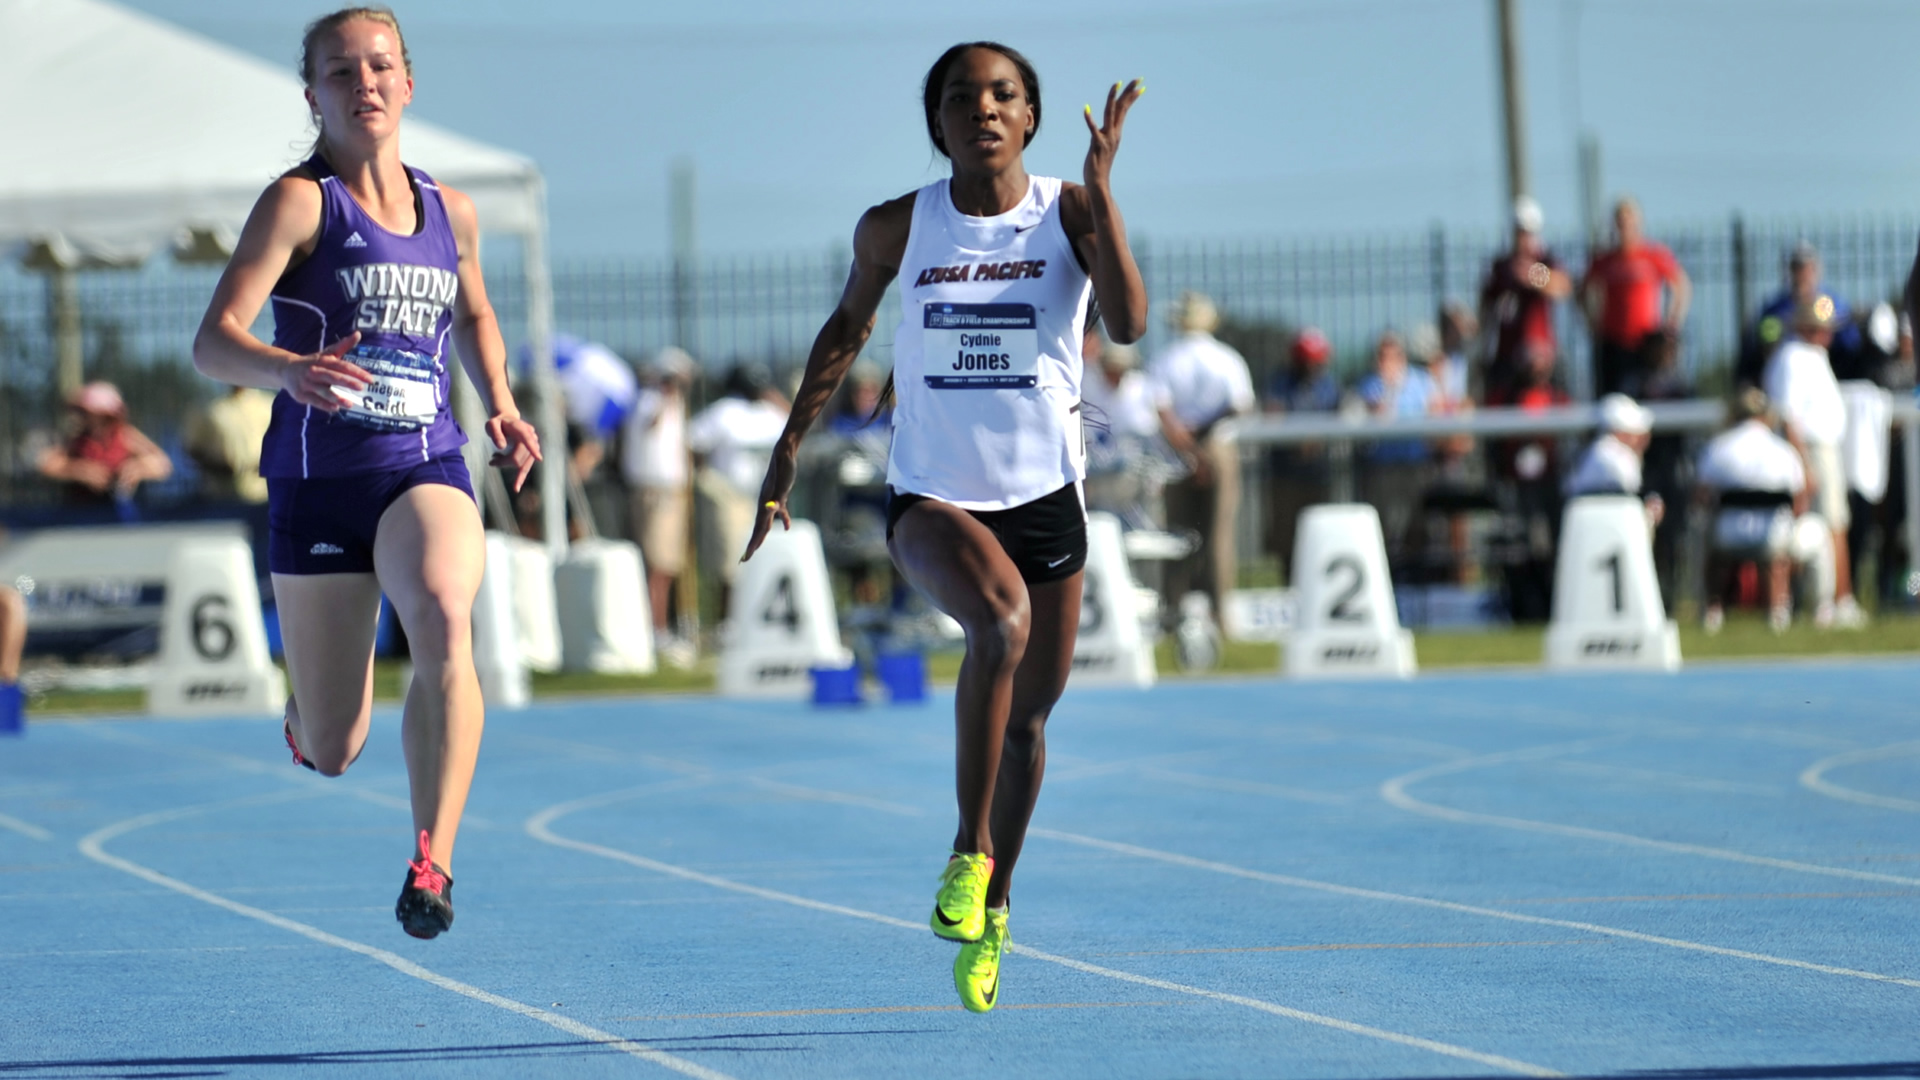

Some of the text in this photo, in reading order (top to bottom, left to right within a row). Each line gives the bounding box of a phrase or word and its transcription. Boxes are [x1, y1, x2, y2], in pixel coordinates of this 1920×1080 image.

[337, 263, 458, 306] WINONA
[914, 259, 1047, 288] AZUSA PACIFIC
[355, 299, 443, 336] STATE
[952, 350, 1011, 371] Jones
[960, 333, 1001, 348] Cydnie
[763, 575, 801, 632] 4
[1325, 557, 1365, 621] 2
[1601, 553, 1623, 613] 1
[190, 595, 235, 662] 6
